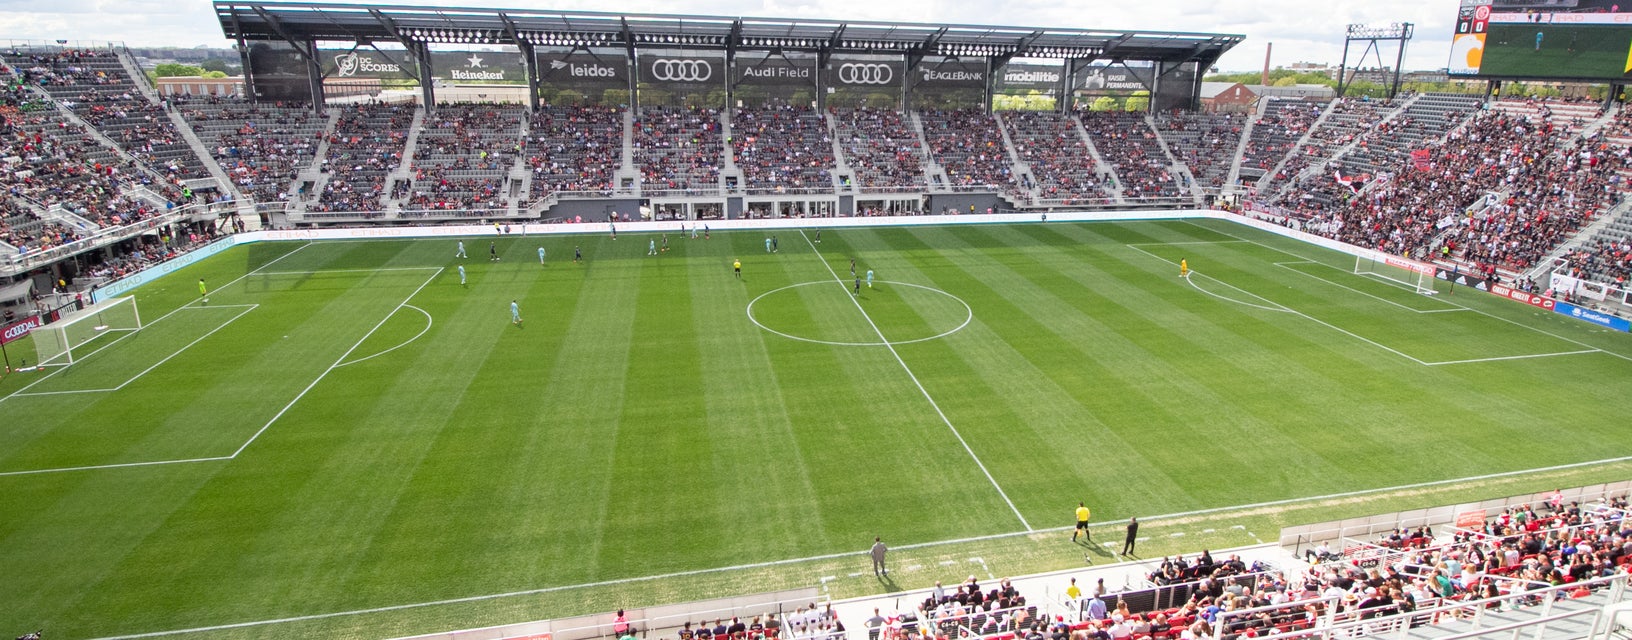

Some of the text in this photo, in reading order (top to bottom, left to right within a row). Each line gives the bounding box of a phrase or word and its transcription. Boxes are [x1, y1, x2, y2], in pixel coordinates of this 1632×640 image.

[1461, 22, 1484, 32] 0 0
[360, 64, 400, 72] SCORES
[570, 63, 616, 77] leidos
[744, 66, 809, 78] Audi Field
[451, 70, 504, 80] Heineken
[1004, 71, 1060, 83] mobilitie
[1107, 74, 1127, 82] KAISER
[266, 231, 319, 239] ETIHAD
[351, 229, 401, 237] ETIHAD
[162, 254, 194, 272] ETIHAD
[104, 276, 142, 296] ETIHAD
